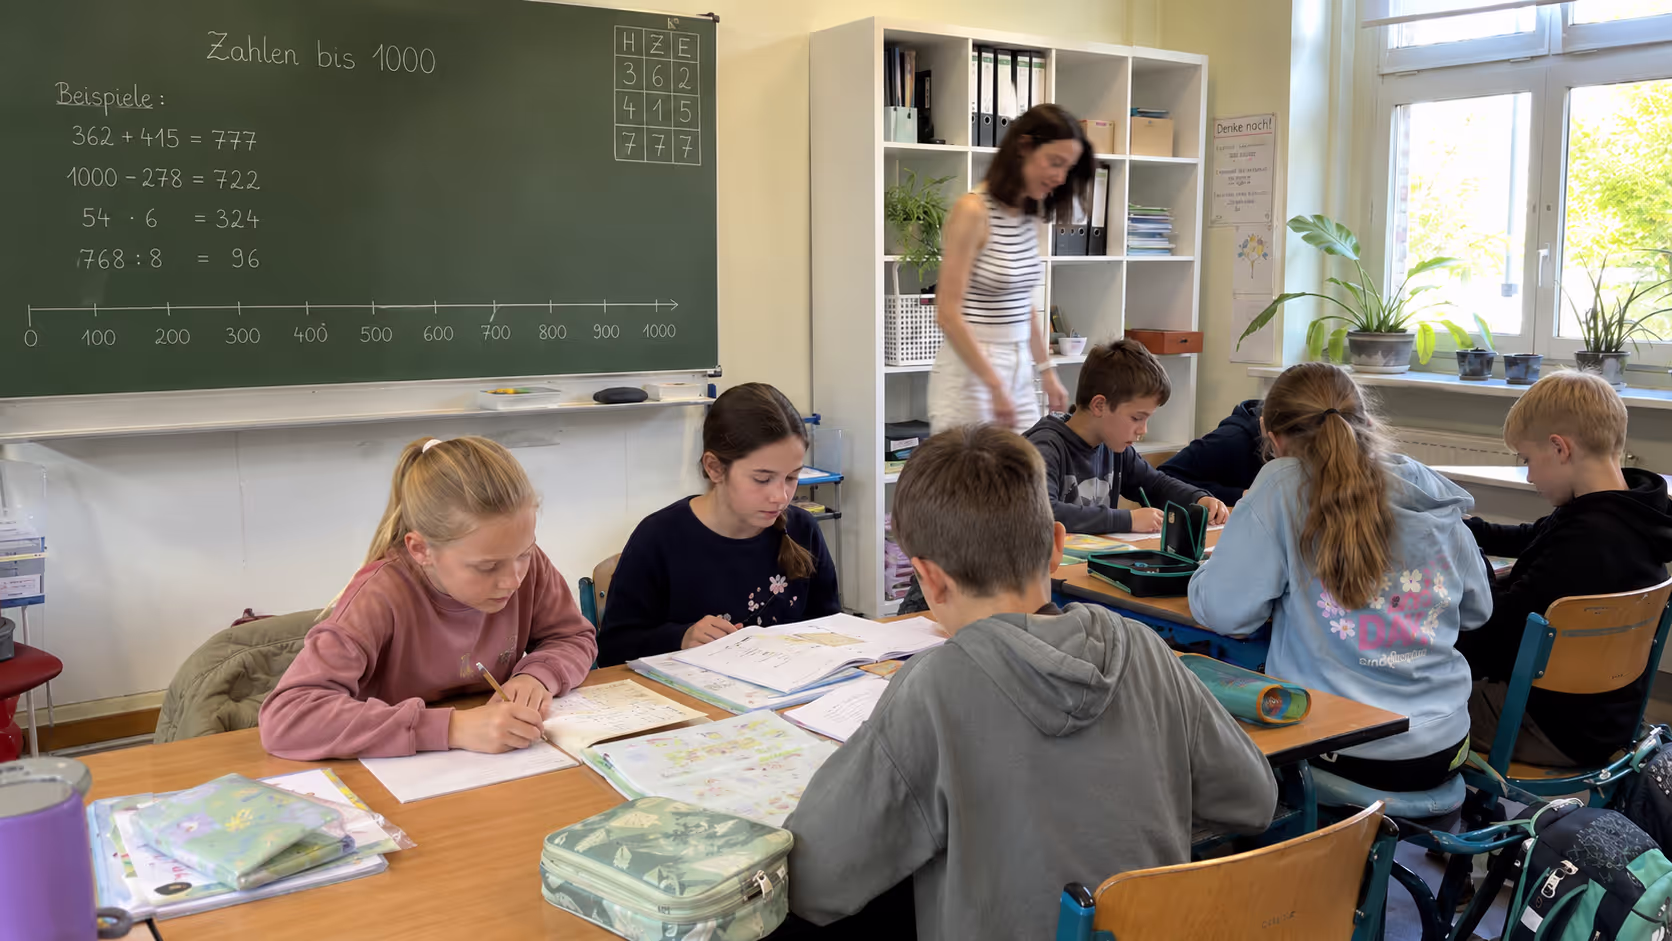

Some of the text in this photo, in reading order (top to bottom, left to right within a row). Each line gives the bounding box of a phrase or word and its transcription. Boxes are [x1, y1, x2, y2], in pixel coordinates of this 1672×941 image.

[206, 30, 436, 74] Zahlen bis 1000
[623, 31, 691, 58] H Z E
[622, 61, 692, 90] 3 6 2
[623, 95, 692, 123] 4 1 5
[71, 124, 115, 147] 362
[140, 127, 180, 149] 415
[211, 129, 257, 152] 777
[1217, 123, 1244, 134] Denke
[622, 131, 693, 159] 7 7 7
[66, 166, 118, 188] 1000
[141, 167, 183, 189] 278
[213, 169, 261, 191] 722
[82, 207, 111, 228] 54
[145, 207, 158, 228] 6
[215, 208, 260, 229] 324
[80, 248, 125, 270] 768
[150, 247, 163, 269] 8
[231, 247, 260, 269] 96
[23, 323, 677, 348] 0 100 200 300 400 500 600 700 800 900 1000
